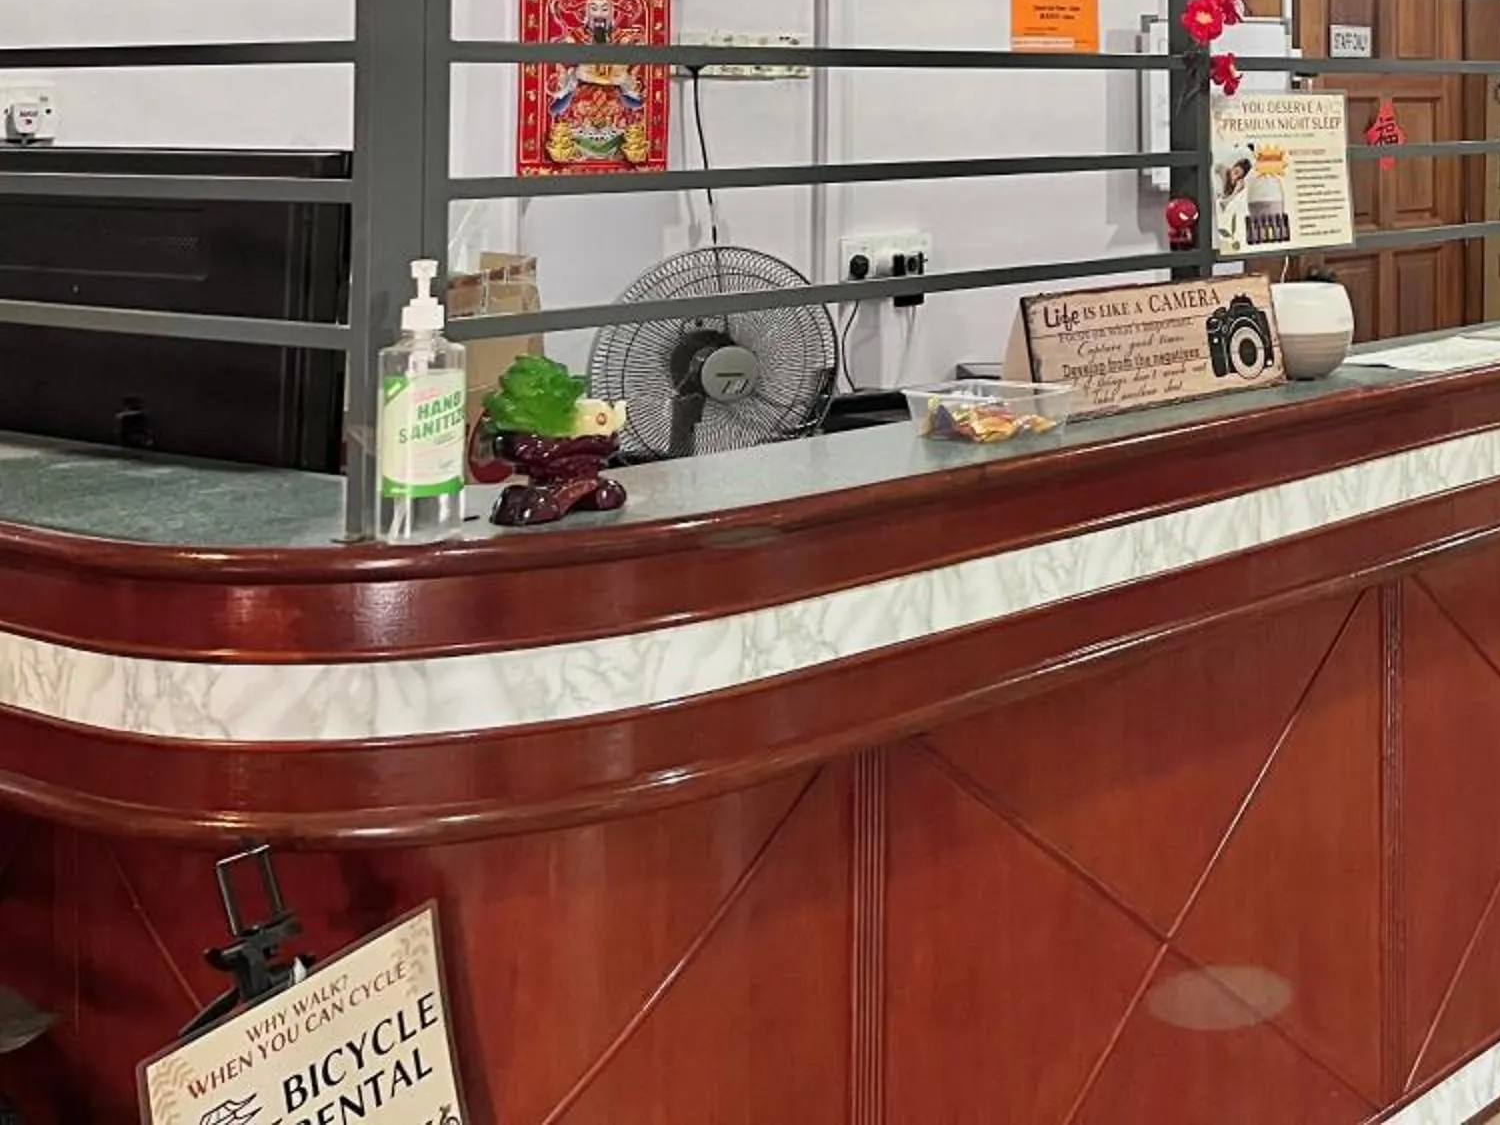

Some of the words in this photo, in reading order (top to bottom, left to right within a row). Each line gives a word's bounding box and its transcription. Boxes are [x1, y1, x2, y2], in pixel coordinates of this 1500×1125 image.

[1223, 117, 1277, 132] PREMIUM
[1278, 117, 1311, 131] NIGHT
[1312, 116, 1341, 130] SLEEP
[1242, 101, 1265, 115] YOU
[1267, 100, 1315, 114] DESERVE
[1315, 100, 1323, 113] A
[1044, 302, 1081, 332] Life
[1083, 306, 1097, 320] IS
[1099, 301, 1129, 318] LIKE
[1135, 301, 1144, 314] A
[1148, 288, 1221, 314] CAMERA
[417, 390, 462, 419] HAND
[186, 1051, 255, 1101] WHEN
[257, 1024, 302, 1062] YOU
[303, 999, 346, 1036] CAN
[349, 959, 408, 1007] CYCLE
[246, 1007, 290, 1045] WHY
[290, 973, 351, 1019] WALK?
[282, 990, 440, 1115] BICYCLE
